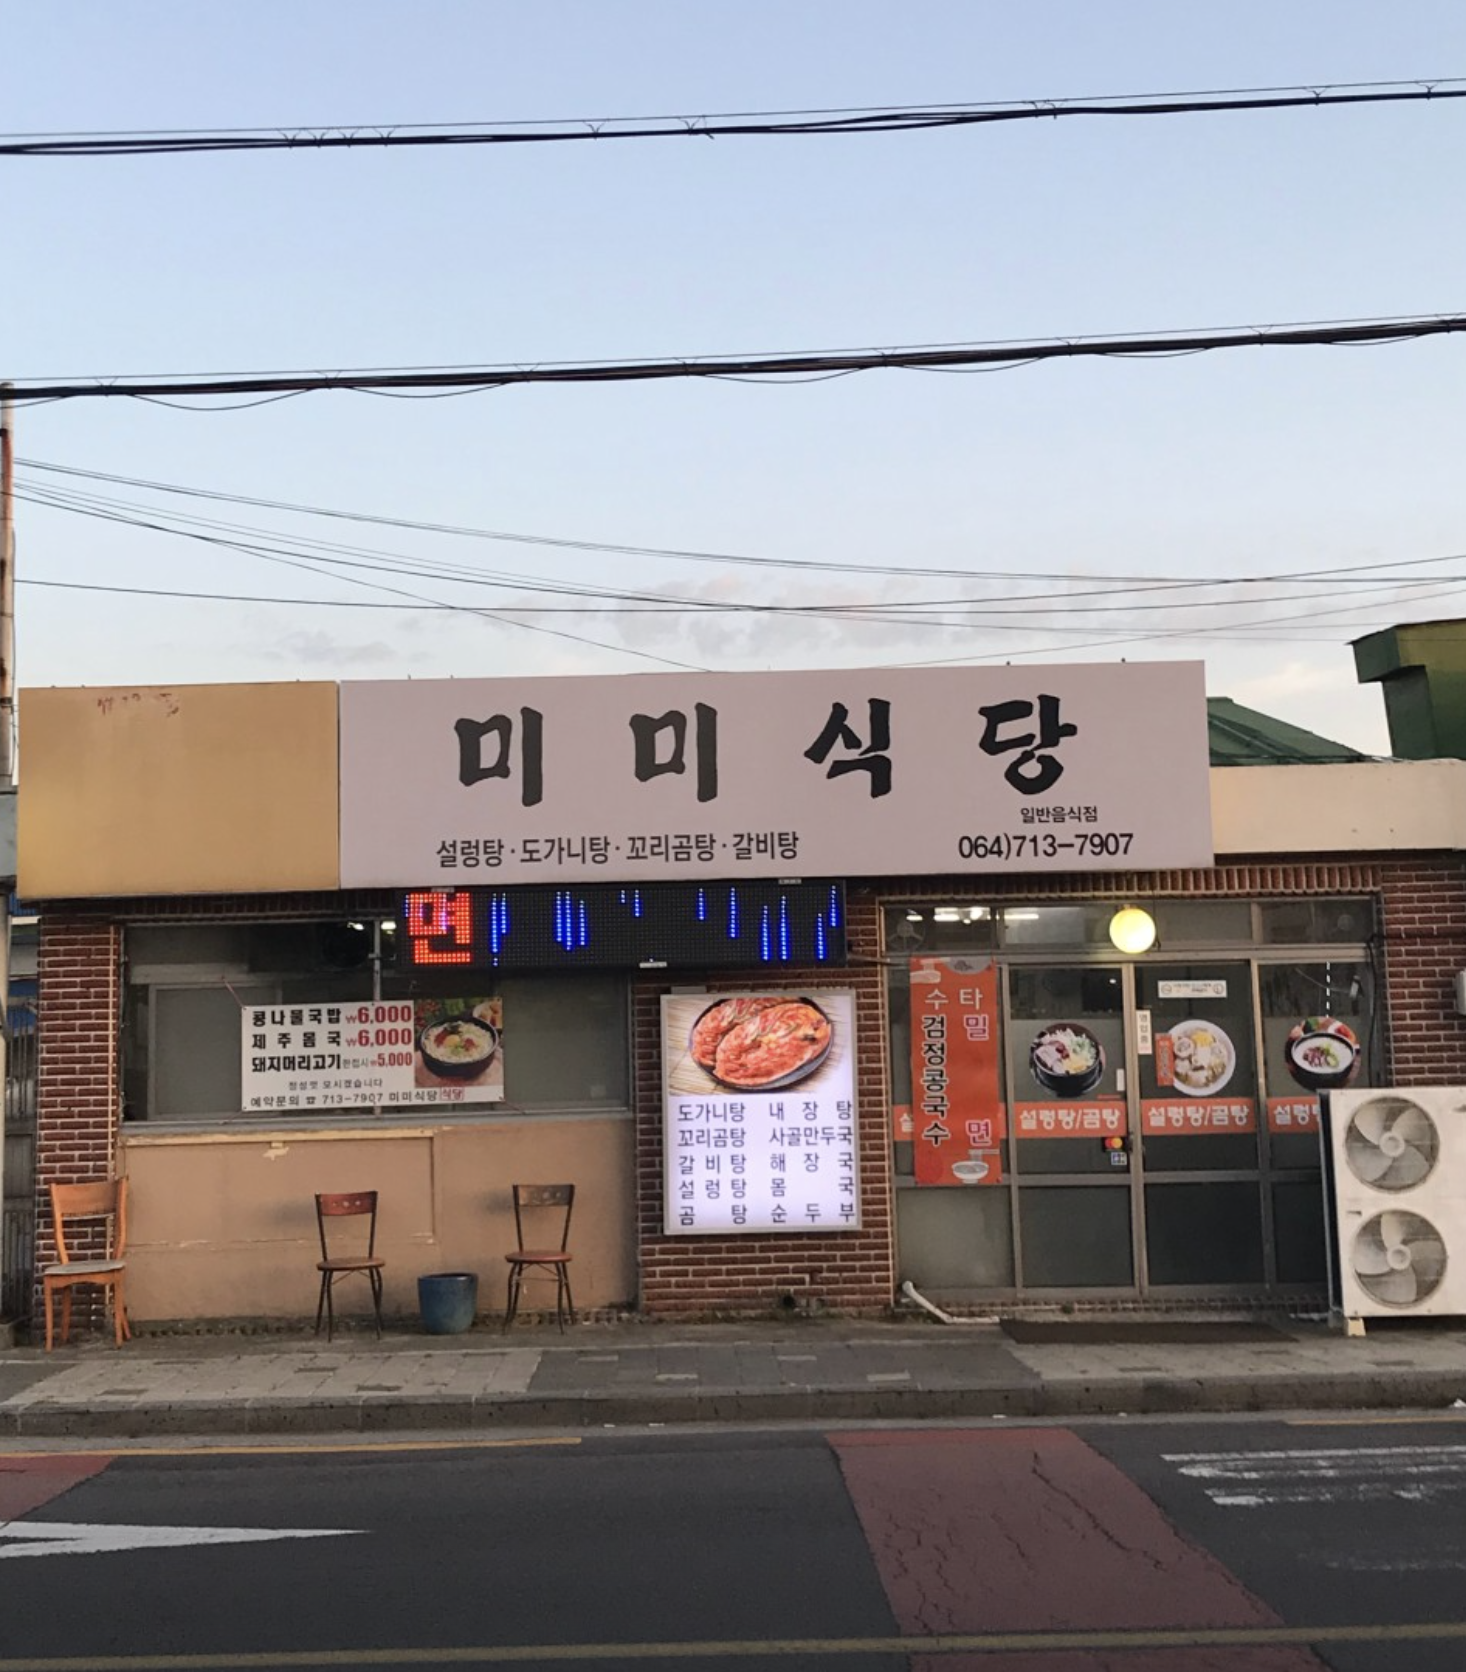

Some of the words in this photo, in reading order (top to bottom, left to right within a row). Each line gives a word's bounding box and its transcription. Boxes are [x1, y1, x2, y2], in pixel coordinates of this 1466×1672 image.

[454, 694, 1077, 807] 미미식당
[1021, 806, 1097, 823] 일반음식점
[436, 839, 504, 868] 설렁탕
[520, 836, 610, 864] 도가니탕
[626, 833, 716, 861] 꼬리곰탕
[732, 831, 799, 859] 갈비탕
[958, 832, 1133, 860] 064)713-7907
[408, 892, 471, 964] 면
[252, 1007, 341, 1027] 콩나물국밥
[252, 1031, 341, 1050] 제주몸국
[252, 1054, 341, 1072] 돼지머리고기
[322, 1078, 383, 1090] 모시겠습니다
[921, 1014, 950, 1146] 검정콩국수
[250, 1094, 300, 1107] 예약문의
[322, 1091, 384, 1105] 713-7907
[388, 1090, 438, 1103] 미미식당
[441, 1087, 464, 1100] 식당
[677, 1102, 746, 1123] 도가니탕
[769, 1100, 852, 1121] 내장탕
[677, 1127, 746, 1148] 꼬리곰탕
[769, 1125, 853, 1146] 사골만두국
[678, 1154, 747, 1175] 갈비탕
[770, 1152, 855, 1173] 해장국
[678, 1178, 747, 1200] 설렁탕
[770, 1176, 855, 1197] 몸국
[678, 1205, 748, 1226] 곰탕
[771, 1203, 856, 1224] 순두부
